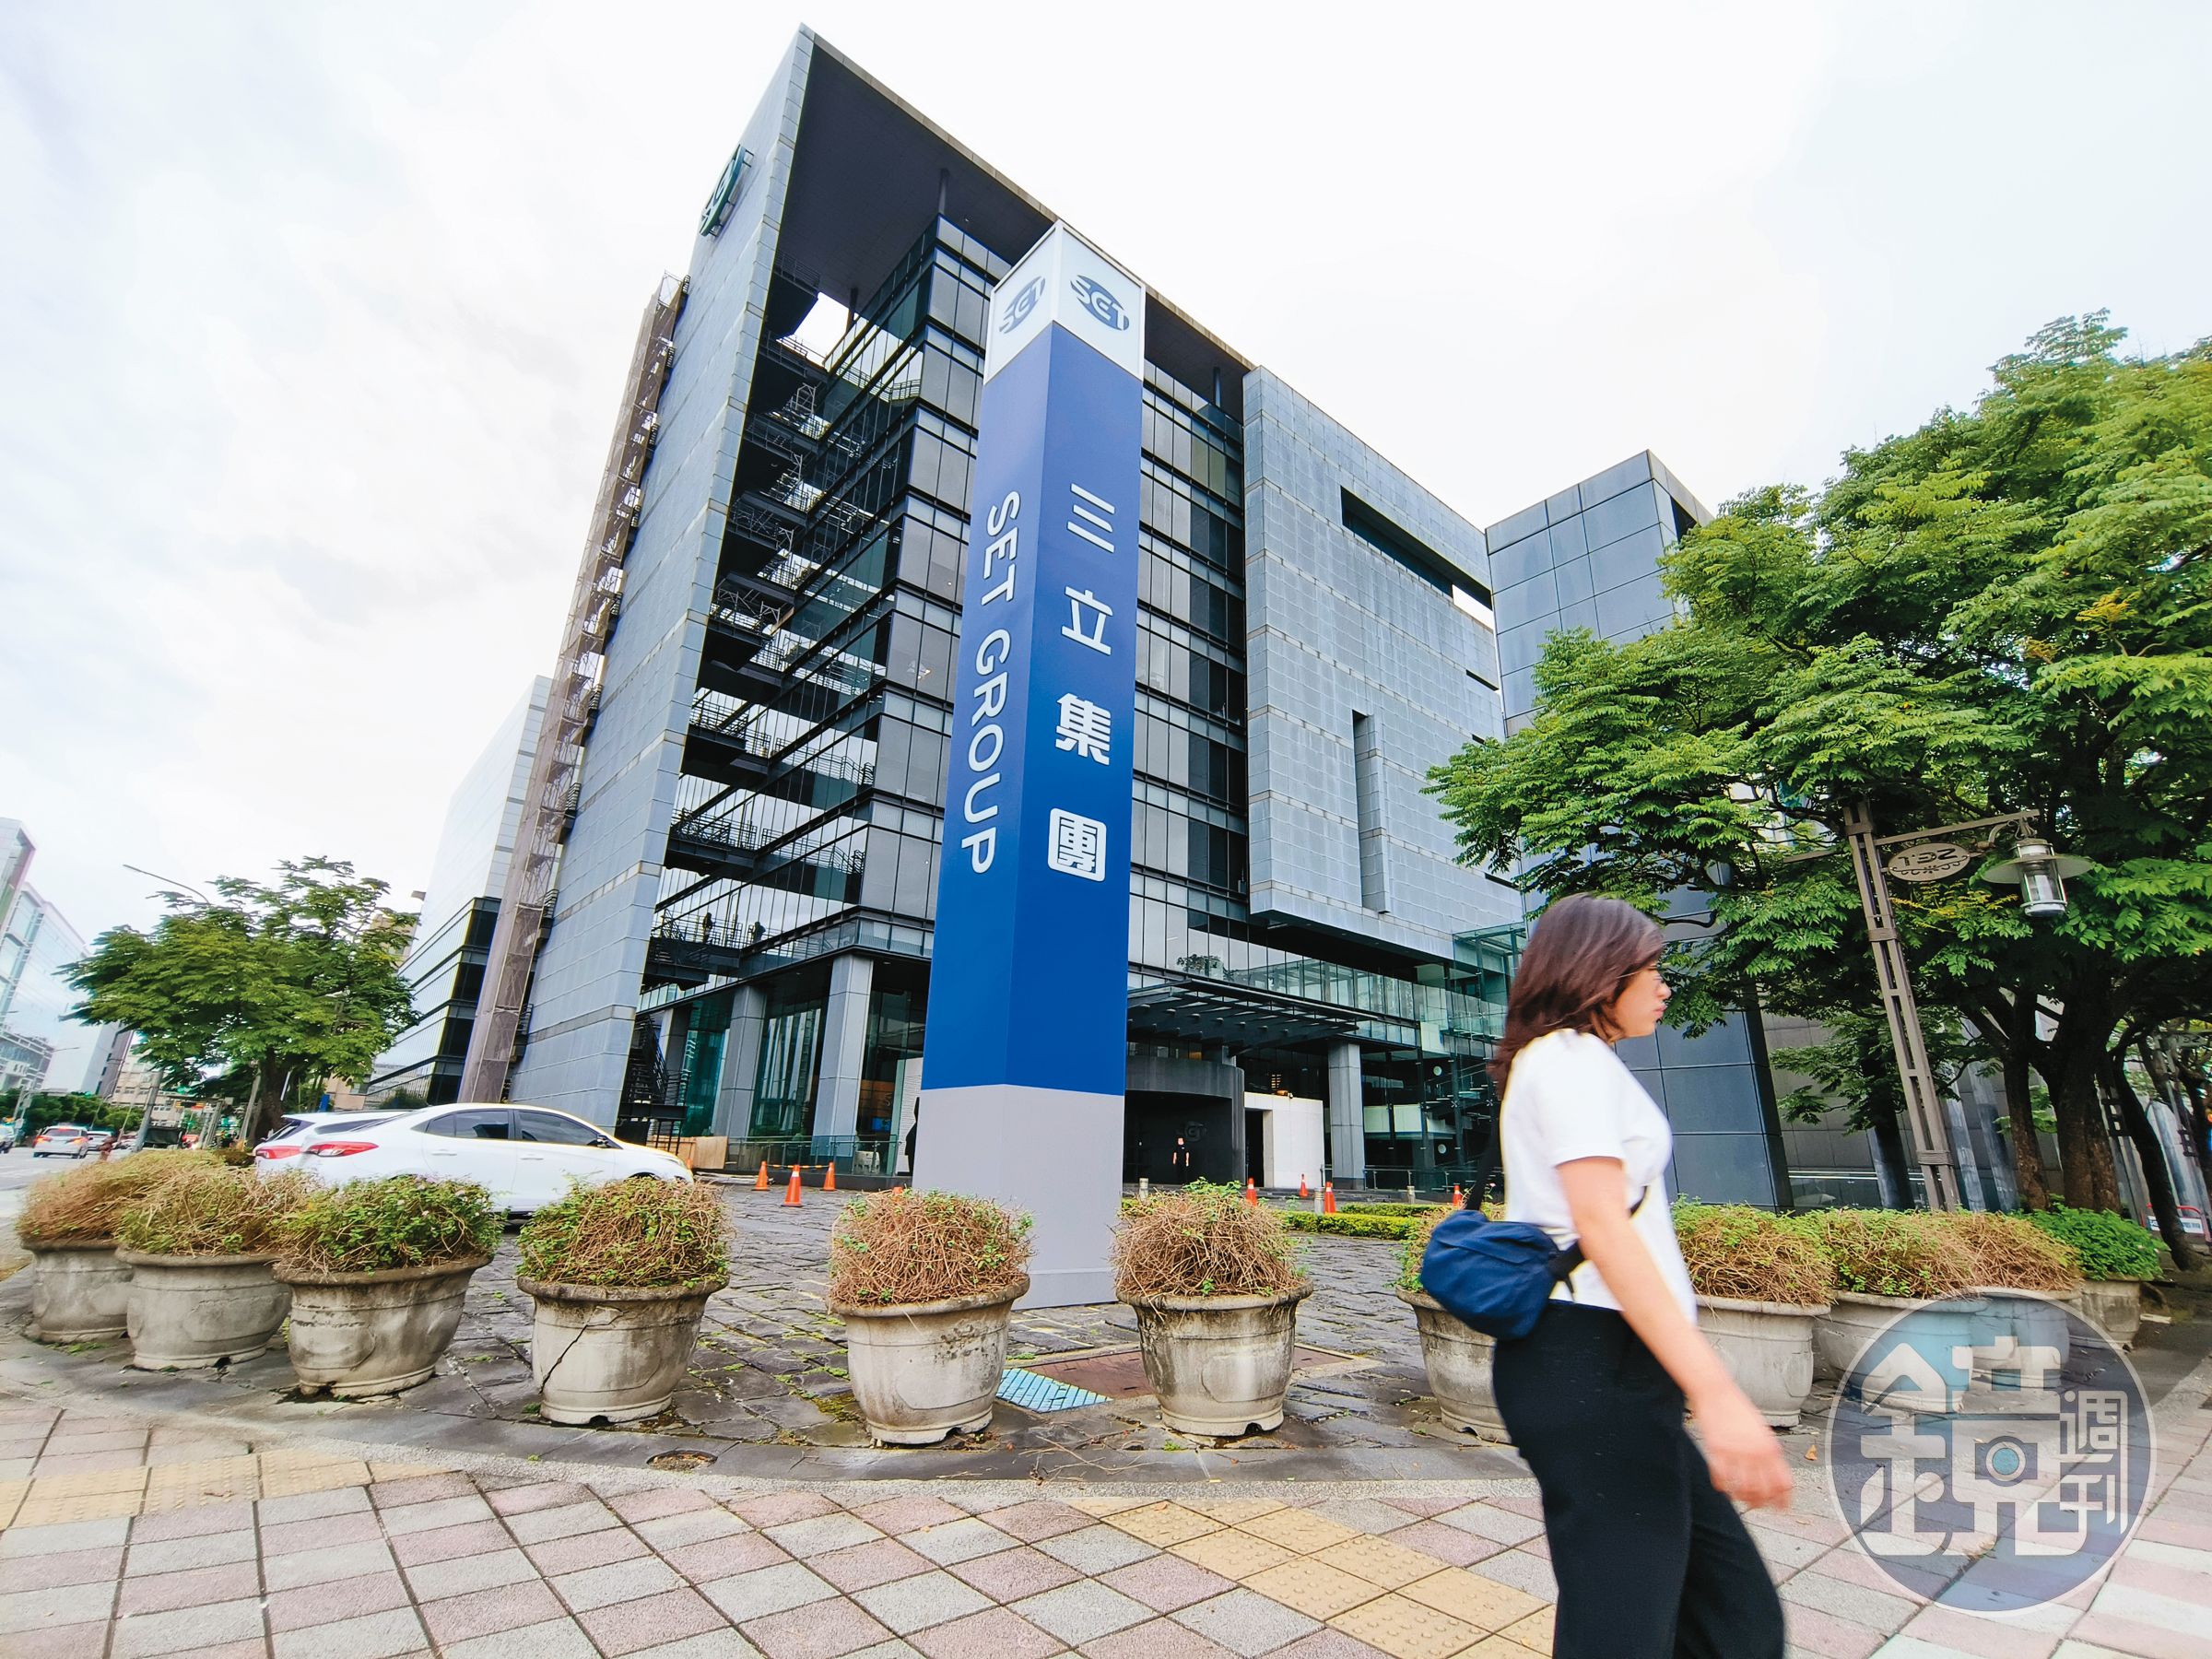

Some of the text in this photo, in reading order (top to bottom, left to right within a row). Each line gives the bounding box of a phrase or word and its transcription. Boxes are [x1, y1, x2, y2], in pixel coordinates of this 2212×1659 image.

[1070, 275, 1129, 331] SET
[961, 490, 1021, 874] SET GROUP
[1047, 483, 1115, 882] 三立集團
